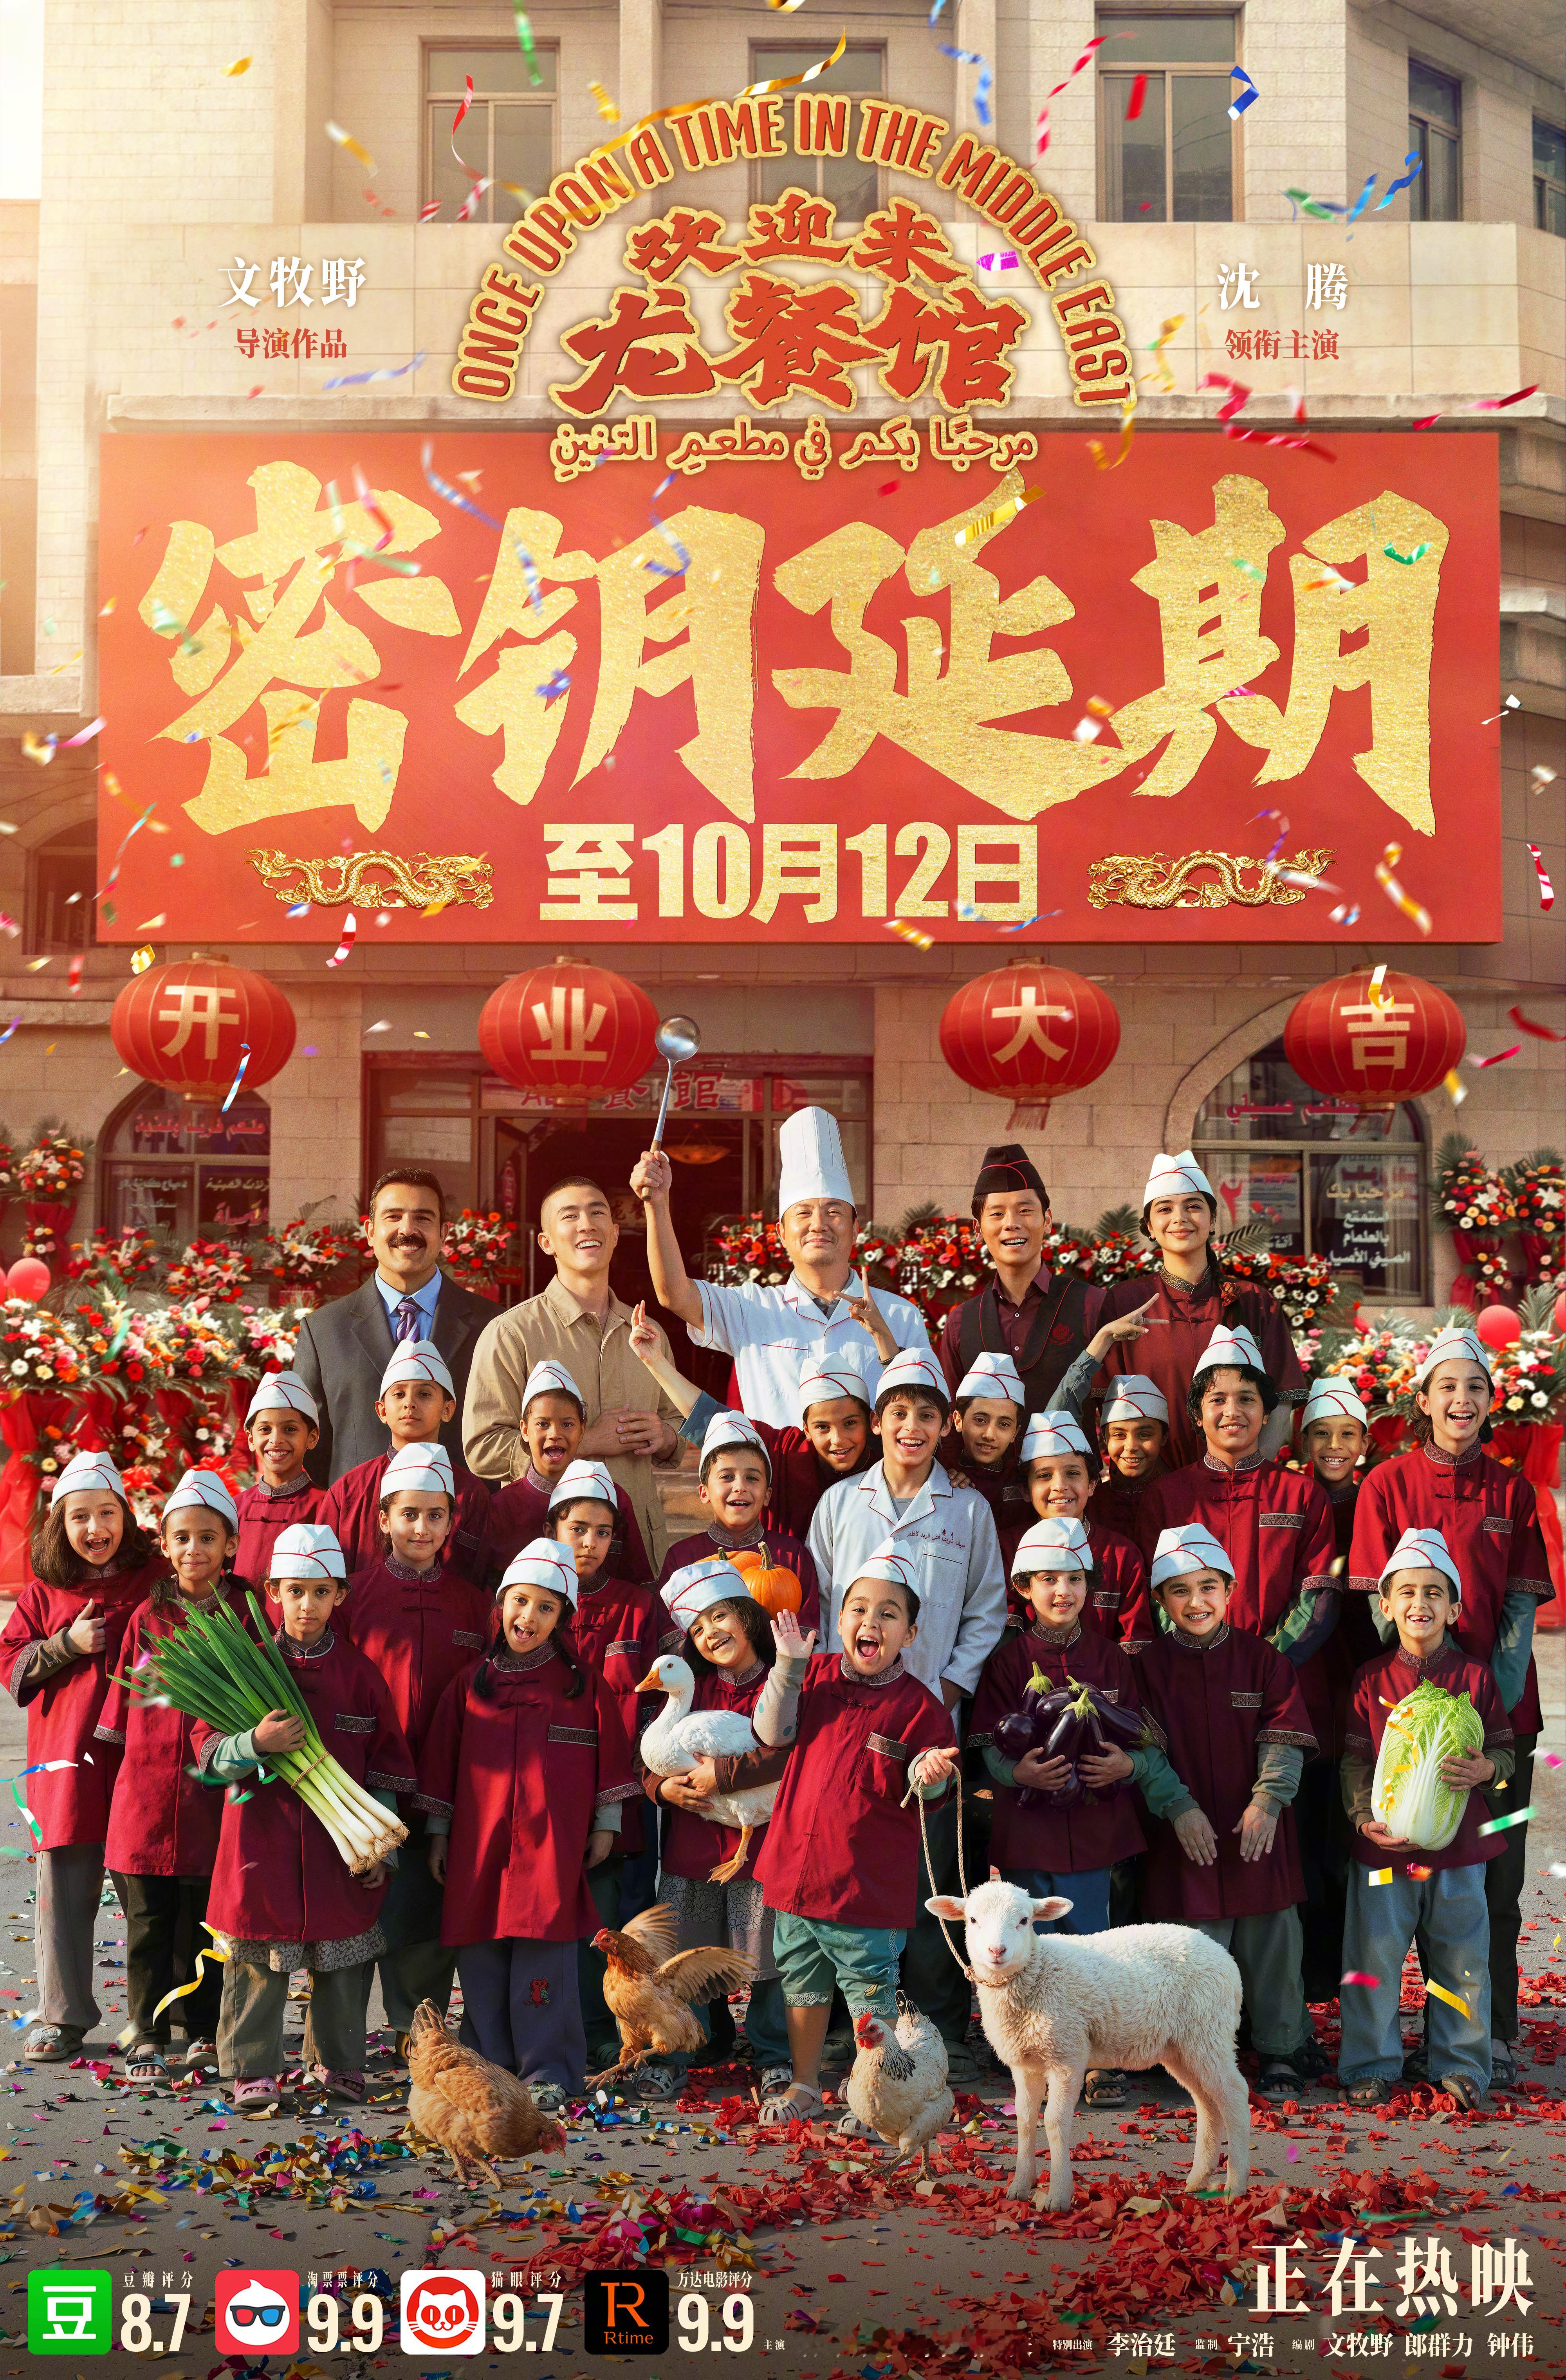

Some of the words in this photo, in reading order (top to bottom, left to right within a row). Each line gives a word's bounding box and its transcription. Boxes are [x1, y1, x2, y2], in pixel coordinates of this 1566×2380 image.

[138, 462, 1451, 835] 密钥延期
[539, 821, 1038, 924] 至10月12日
[159, 985, 239, 1060] 开
[530, 986, 607, 1062] 业
[992, 986, 1068, 1063] 大
[1340, 994, 1414, 1070] 吉
